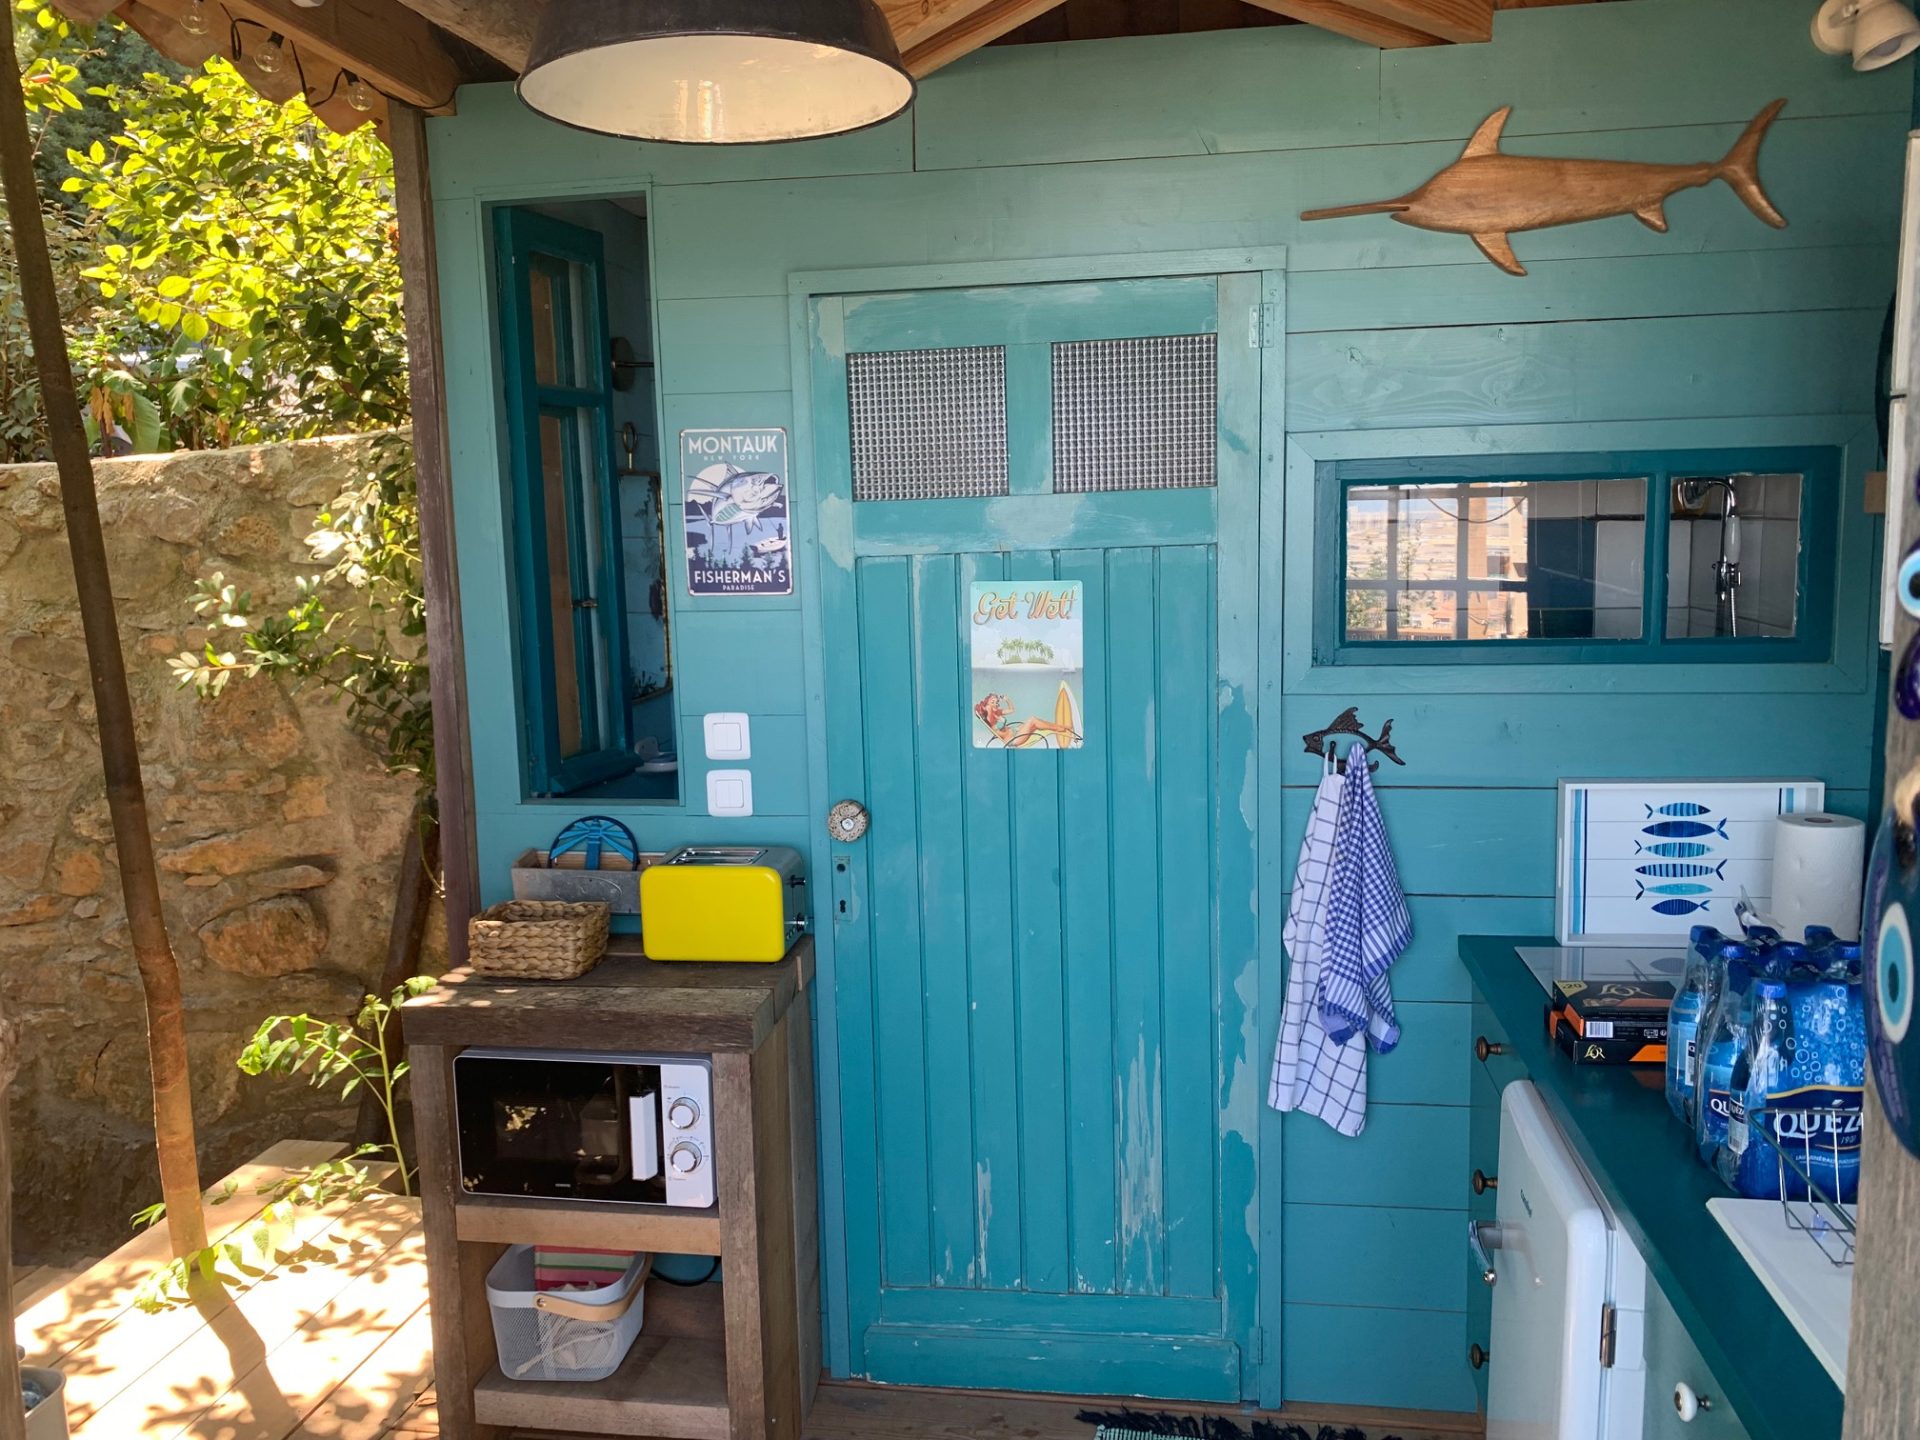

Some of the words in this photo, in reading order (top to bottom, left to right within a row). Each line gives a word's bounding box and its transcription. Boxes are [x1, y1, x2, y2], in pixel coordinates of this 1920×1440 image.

[688, 435, 777, 454] MONTAUK
[694, 569, 786, 584] FISHERMAN'S
[973, 591, 1018, 625] Get
[1024, 589, 1076, 620] Wet!
